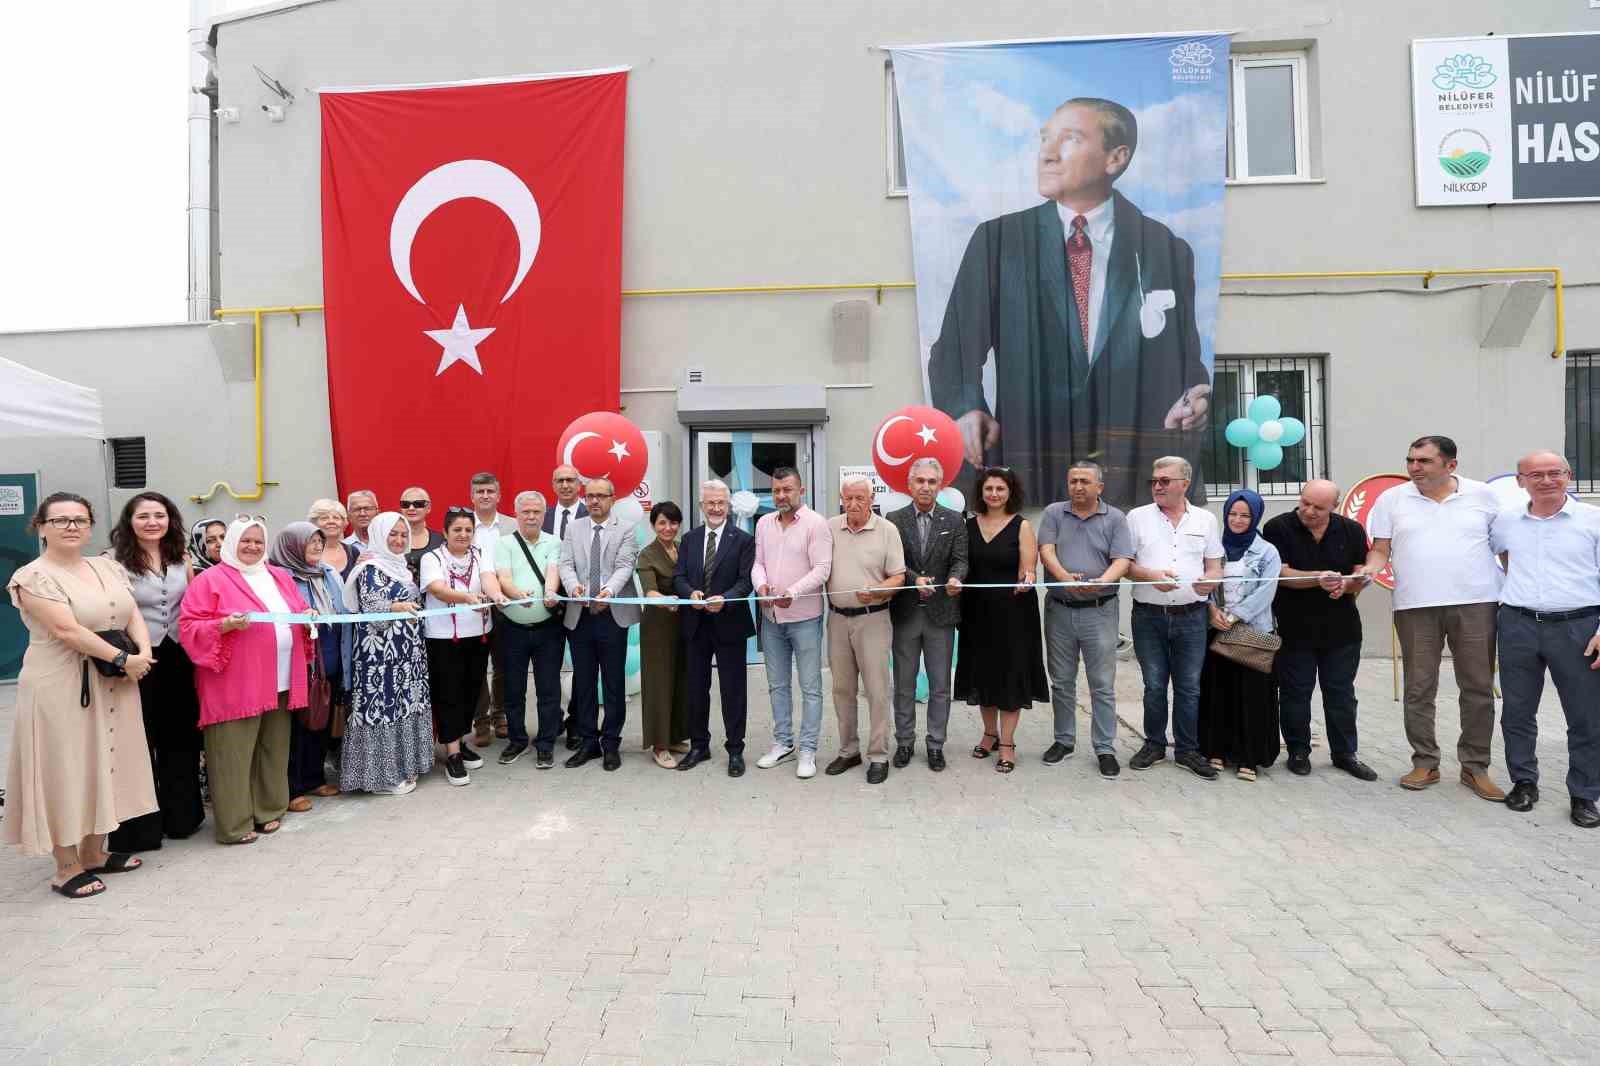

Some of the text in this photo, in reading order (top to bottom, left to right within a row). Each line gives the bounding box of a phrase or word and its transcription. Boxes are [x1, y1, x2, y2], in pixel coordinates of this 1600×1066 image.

[1438, 90, 1494, 101] NİLÜFER
[1516, 69, 1597, 104] NİLÜF
[1439, 101, 1493, 111] BELEDİYESİ
[1518, 121, 1600, 164] HAS
